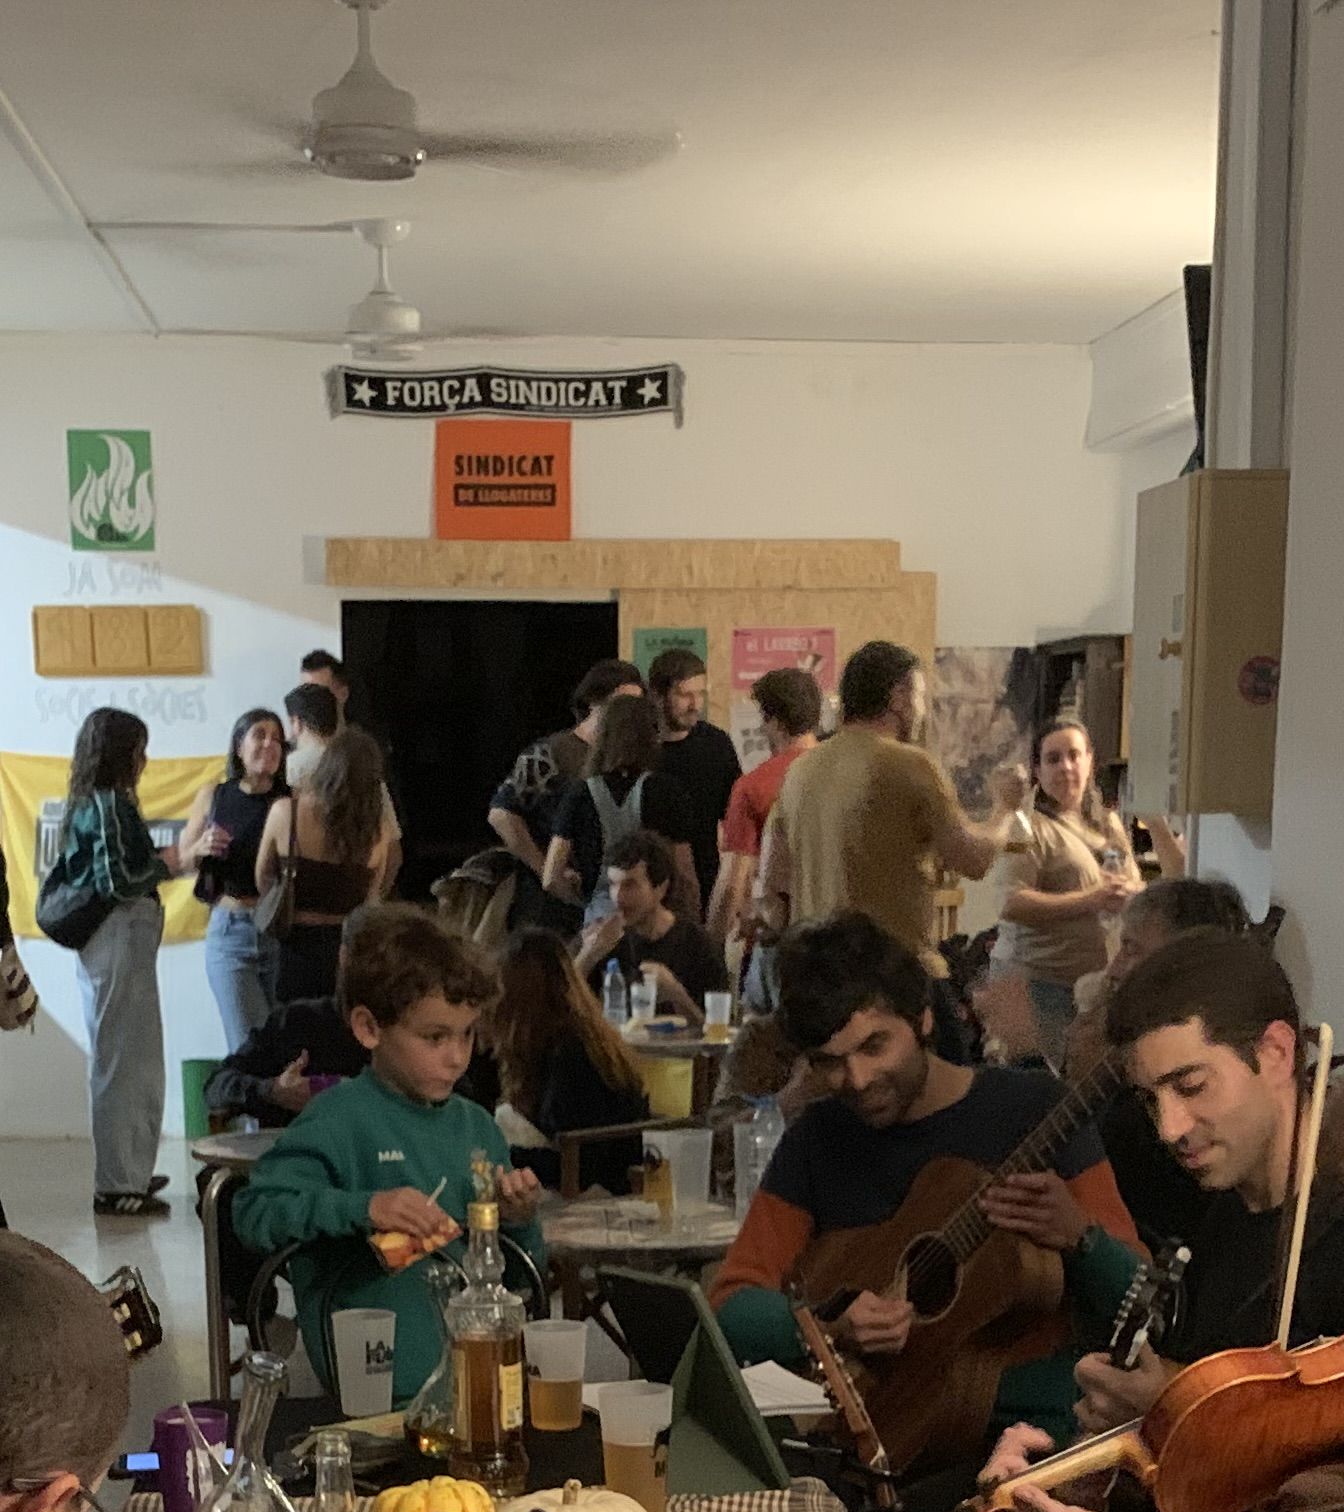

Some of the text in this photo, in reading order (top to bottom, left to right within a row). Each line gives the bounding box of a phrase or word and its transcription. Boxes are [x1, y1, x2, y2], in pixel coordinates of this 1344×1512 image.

[385, 377, 628, 412] FORÇA SINDICAT
[455, 455, 555, 477] SINDICAT
